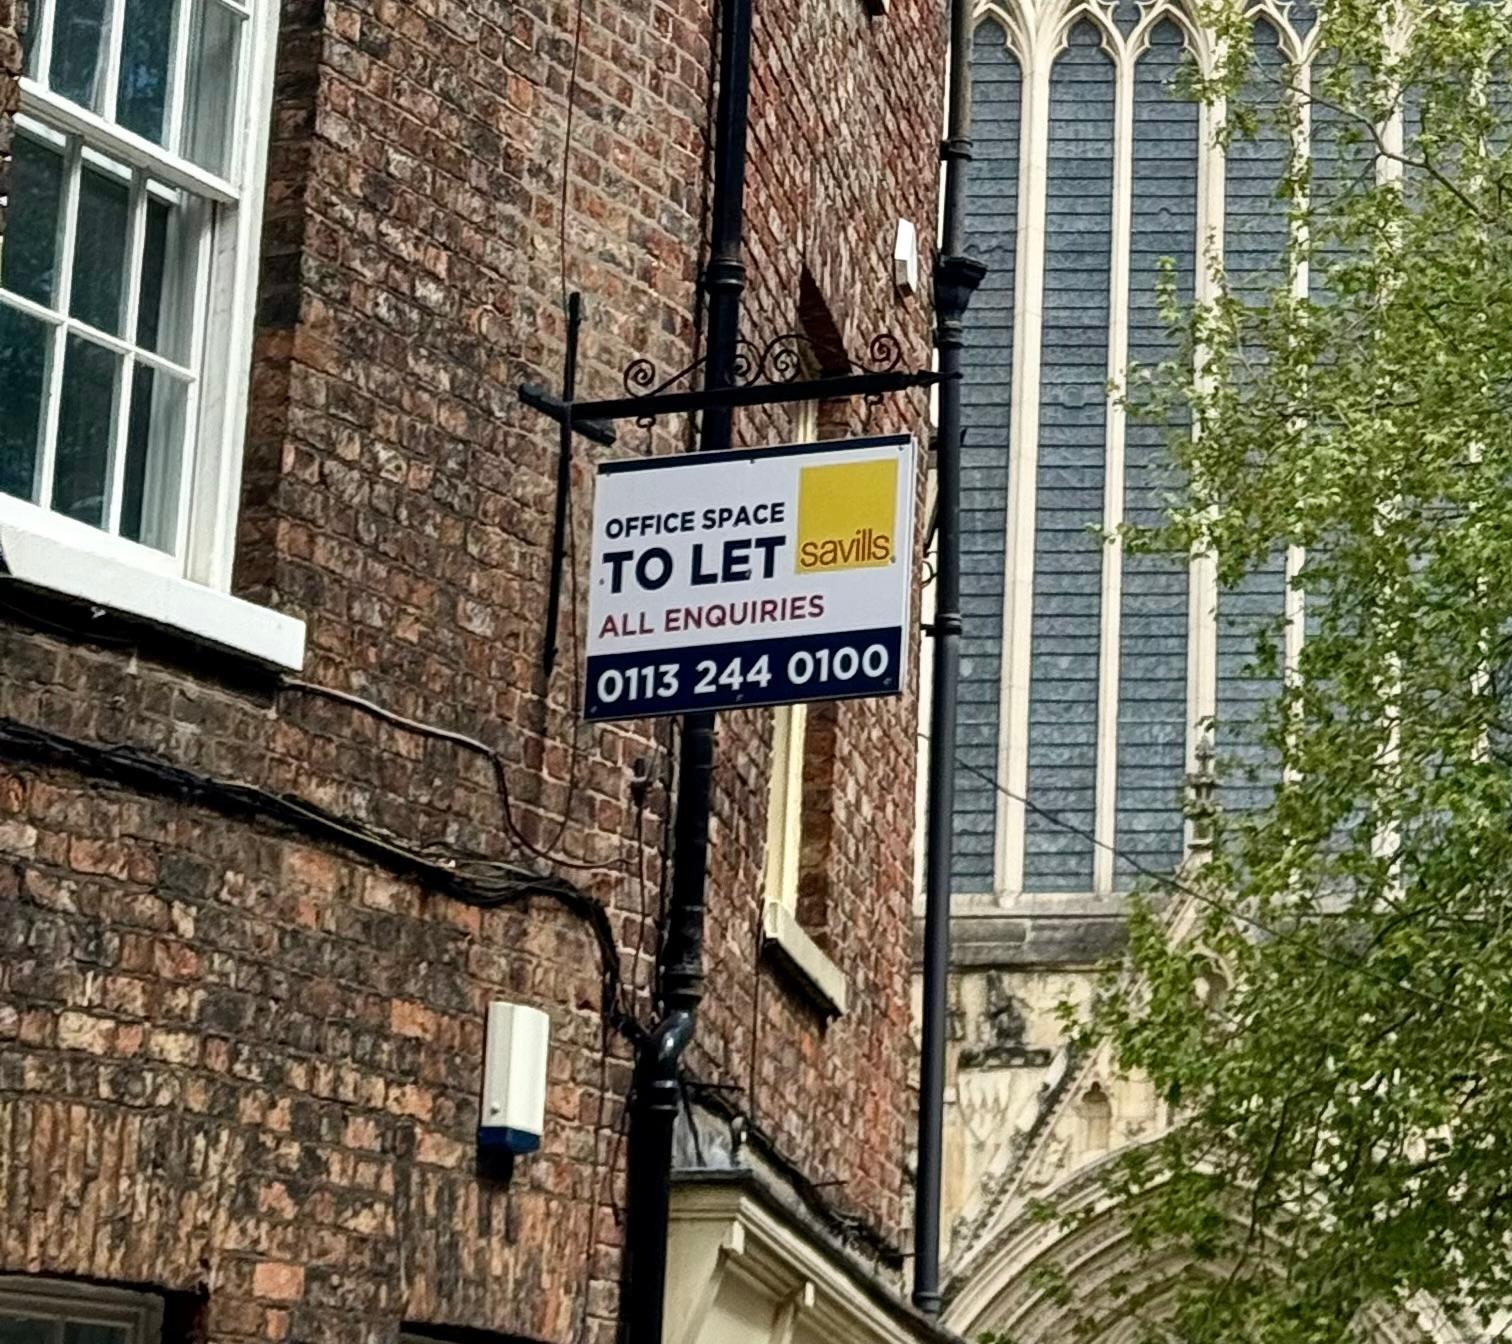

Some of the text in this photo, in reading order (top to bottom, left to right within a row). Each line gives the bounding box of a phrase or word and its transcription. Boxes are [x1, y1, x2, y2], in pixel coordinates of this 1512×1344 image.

[606, 503, 785, 539] OFFICE SPACE
[603, 536, 786, 593] TO LET
[800, 529, 890, 568] savills
[599, 595, 824, 638] ALL ENQUIRIES
[597, 644, 888, 702] 0113 244 0100
